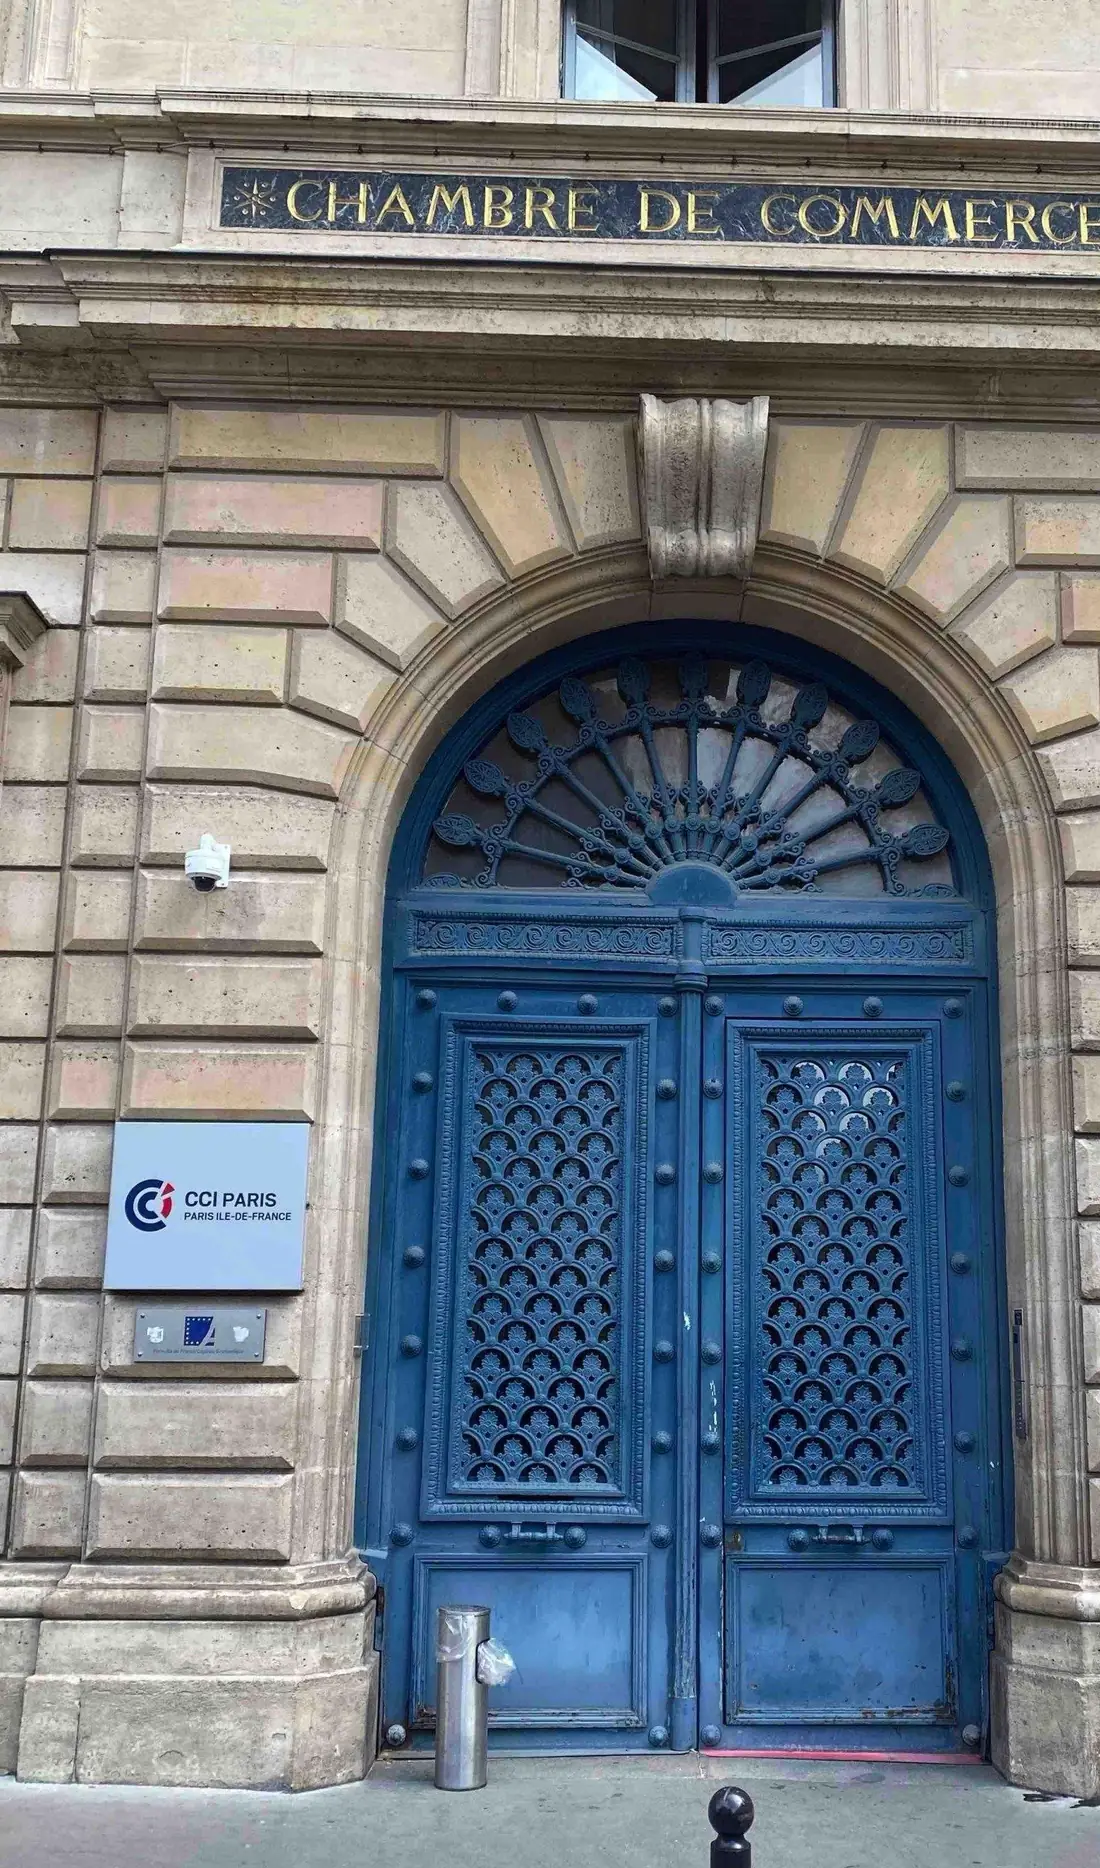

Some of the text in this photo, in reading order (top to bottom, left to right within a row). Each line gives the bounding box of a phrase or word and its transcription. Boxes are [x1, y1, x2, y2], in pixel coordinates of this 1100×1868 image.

[286, 179, 601, 232] CHAMBRE
[638, 188, 720, 234] DE
[185, 1191, 277, 1208] CCI PARIS
[184, 1211, 292, 1222] PARIS ILE-DE-FRANCE
